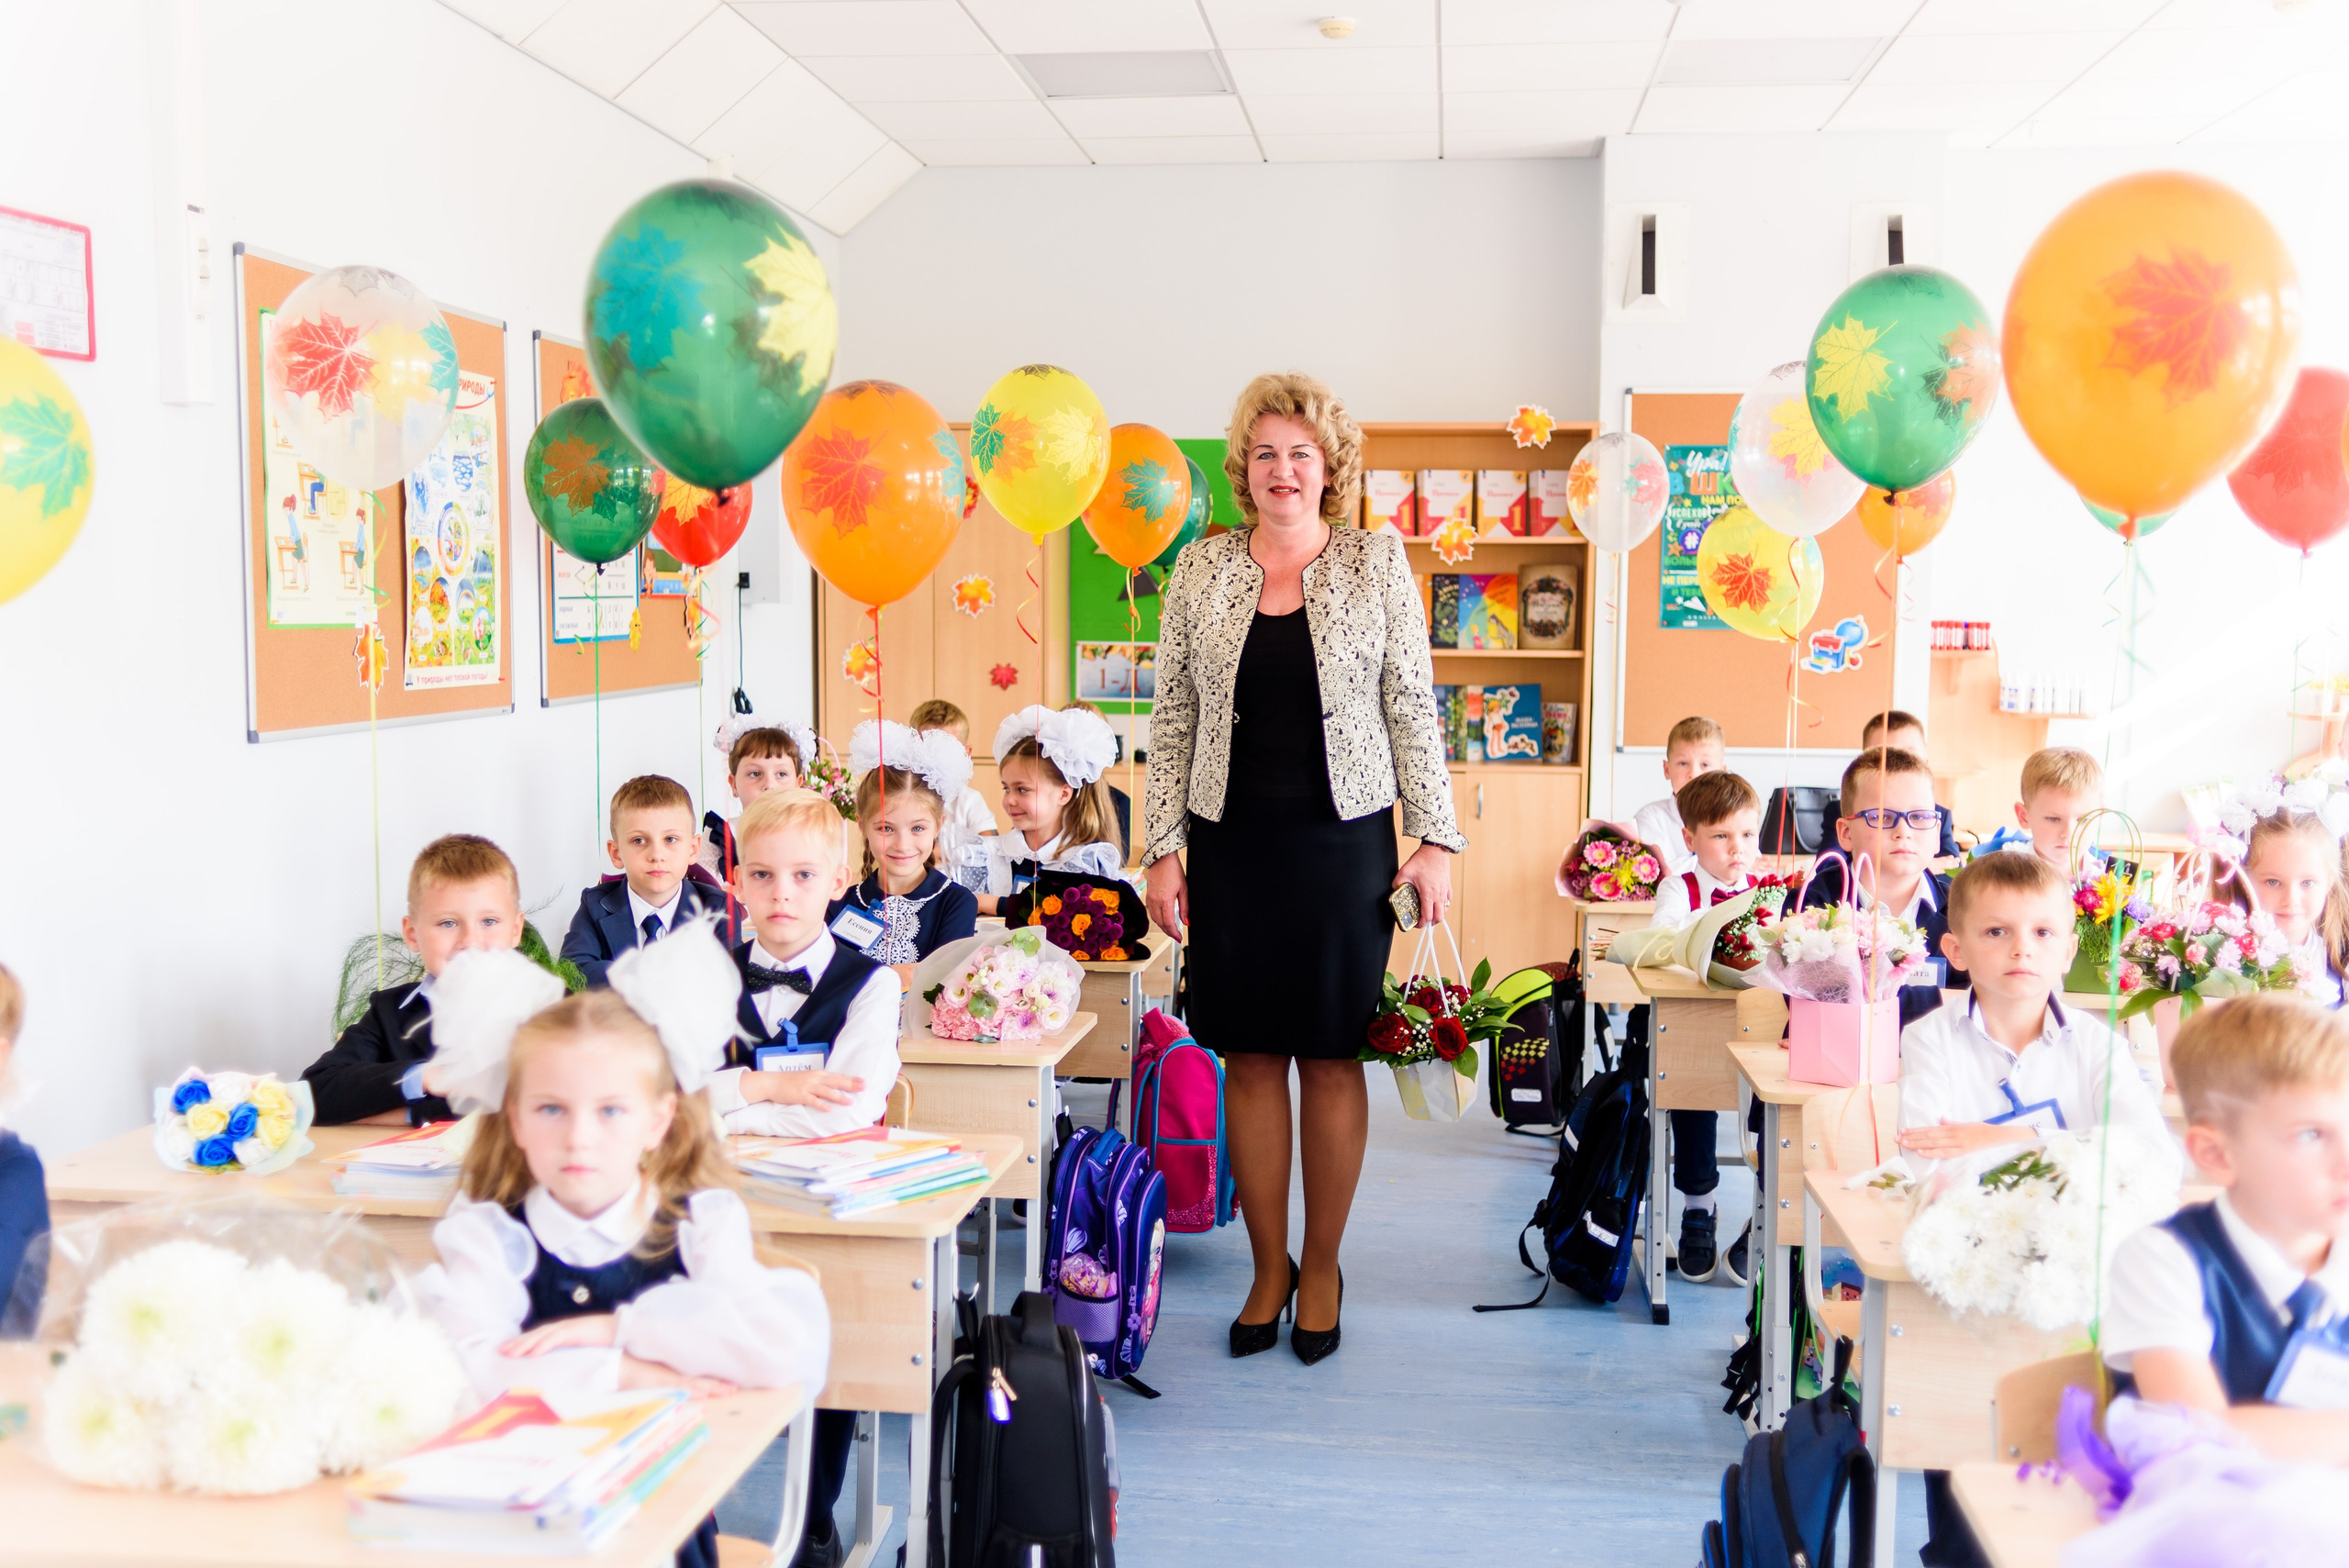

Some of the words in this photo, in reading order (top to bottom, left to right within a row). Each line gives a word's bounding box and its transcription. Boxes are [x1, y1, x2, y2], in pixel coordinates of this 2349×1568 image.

[1686, 450, 1729, 478] Ура!
[1669, 472, 1686, 495] В
[1689, 471, 1737, 495] ШК
[847, 917, 873, 935] Есения
[777, 1062, 812, 1073] Артём
